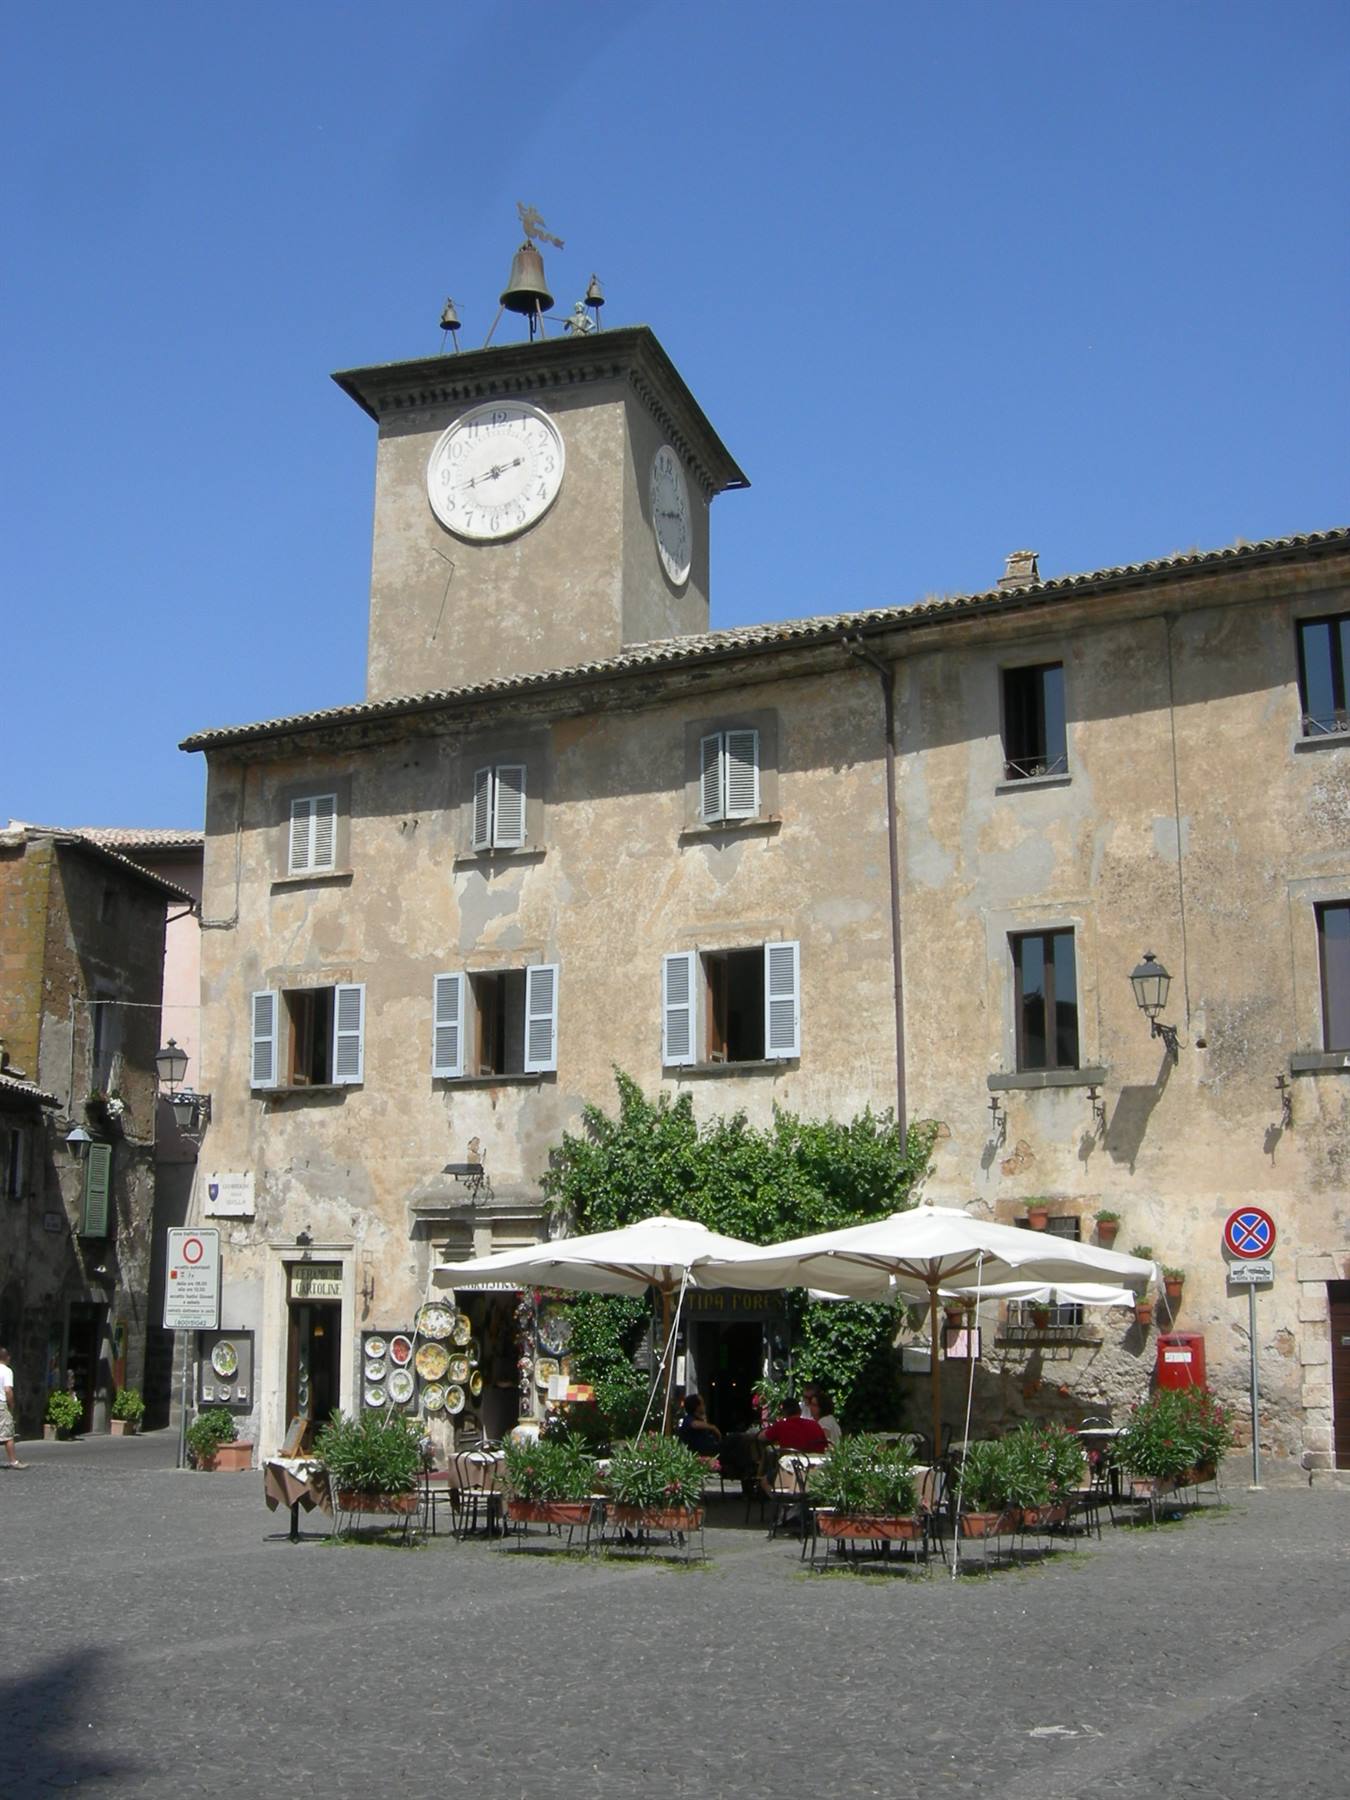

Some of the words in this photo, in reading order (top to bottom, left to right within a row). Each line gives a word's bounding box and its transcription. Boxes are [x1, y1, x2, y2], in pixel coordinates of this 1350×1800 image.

[491, 412, 508, 428] 12
[468, 421, 479, 439] 11
[539, 430, 549, 447] 2
[447, 442, 463, 460] 10
[545, 456, 555, 473] 3
[441, 469, 451, 487] 9
[536, 482, 547, 500] 4
[447, 495, 456, 511] 8
[464, 511, 473, 528] 7
[490, 514, 500, 532] 6
[295, 1282, 343, 1297] CARTOLINE
